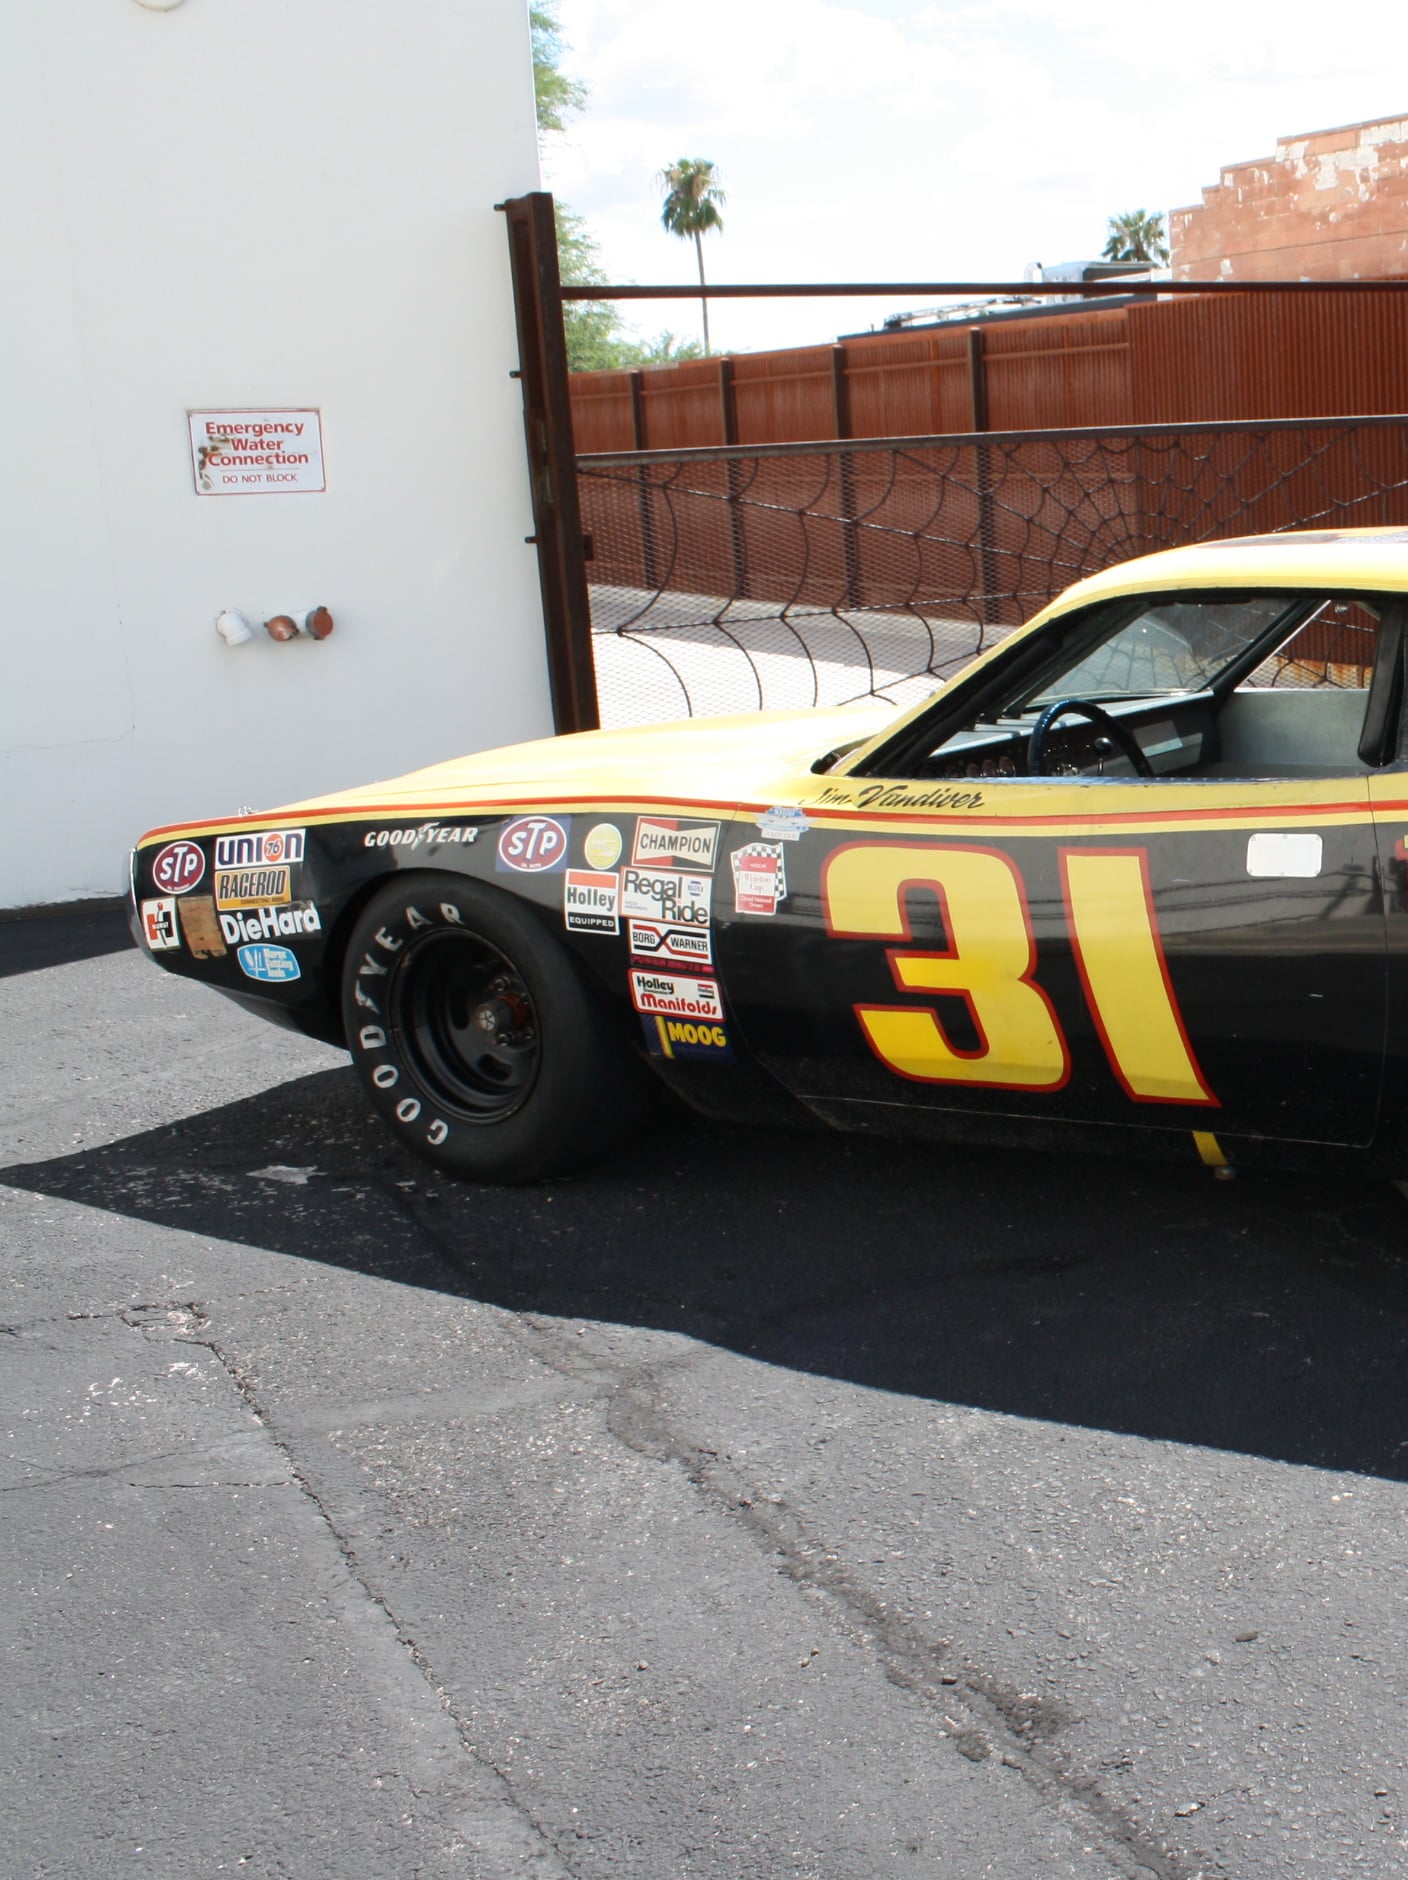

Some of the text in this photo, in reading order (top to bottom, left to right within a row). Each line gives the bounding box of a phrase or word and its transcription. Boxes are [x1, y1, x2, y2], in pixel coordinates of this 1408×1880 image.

[205, 421, 305, 437] Emergency
[231, 438, 284, 451] Water
[208, 451, 309, 466] Connection
[222, 473, 298, 484] DO NOT BLOCK
[857, 784, 985, 809] Vandiver
[266, 839, 281, 856] 76
[364, 822, 479, 850] GOODYEAR
[508, 822, 558, 859] STP
[640, 833, 712, 854] CHAMPION
[160, 846, 198, 882] STP
[219, 869, 287, 900] RACEROD
[623, 870, 683, 902] Regal
[567, 886, 616, 912] Holley
[661, 898, 709, 925] Ride
[219, 900, 322, 945] DieHard
[569, 916, 615, 927] EQUIPPED
[632, 931, 709, 952] BORG WARNER
[636, 975, 675, 995] Holley
[820, 839, 1223, 1107] 31
[640, 993, 718, 1015] Manifolds
[355, 902, 465, 1146] GOODYEAR
[666, 1021, 728, 1048] MOOG
